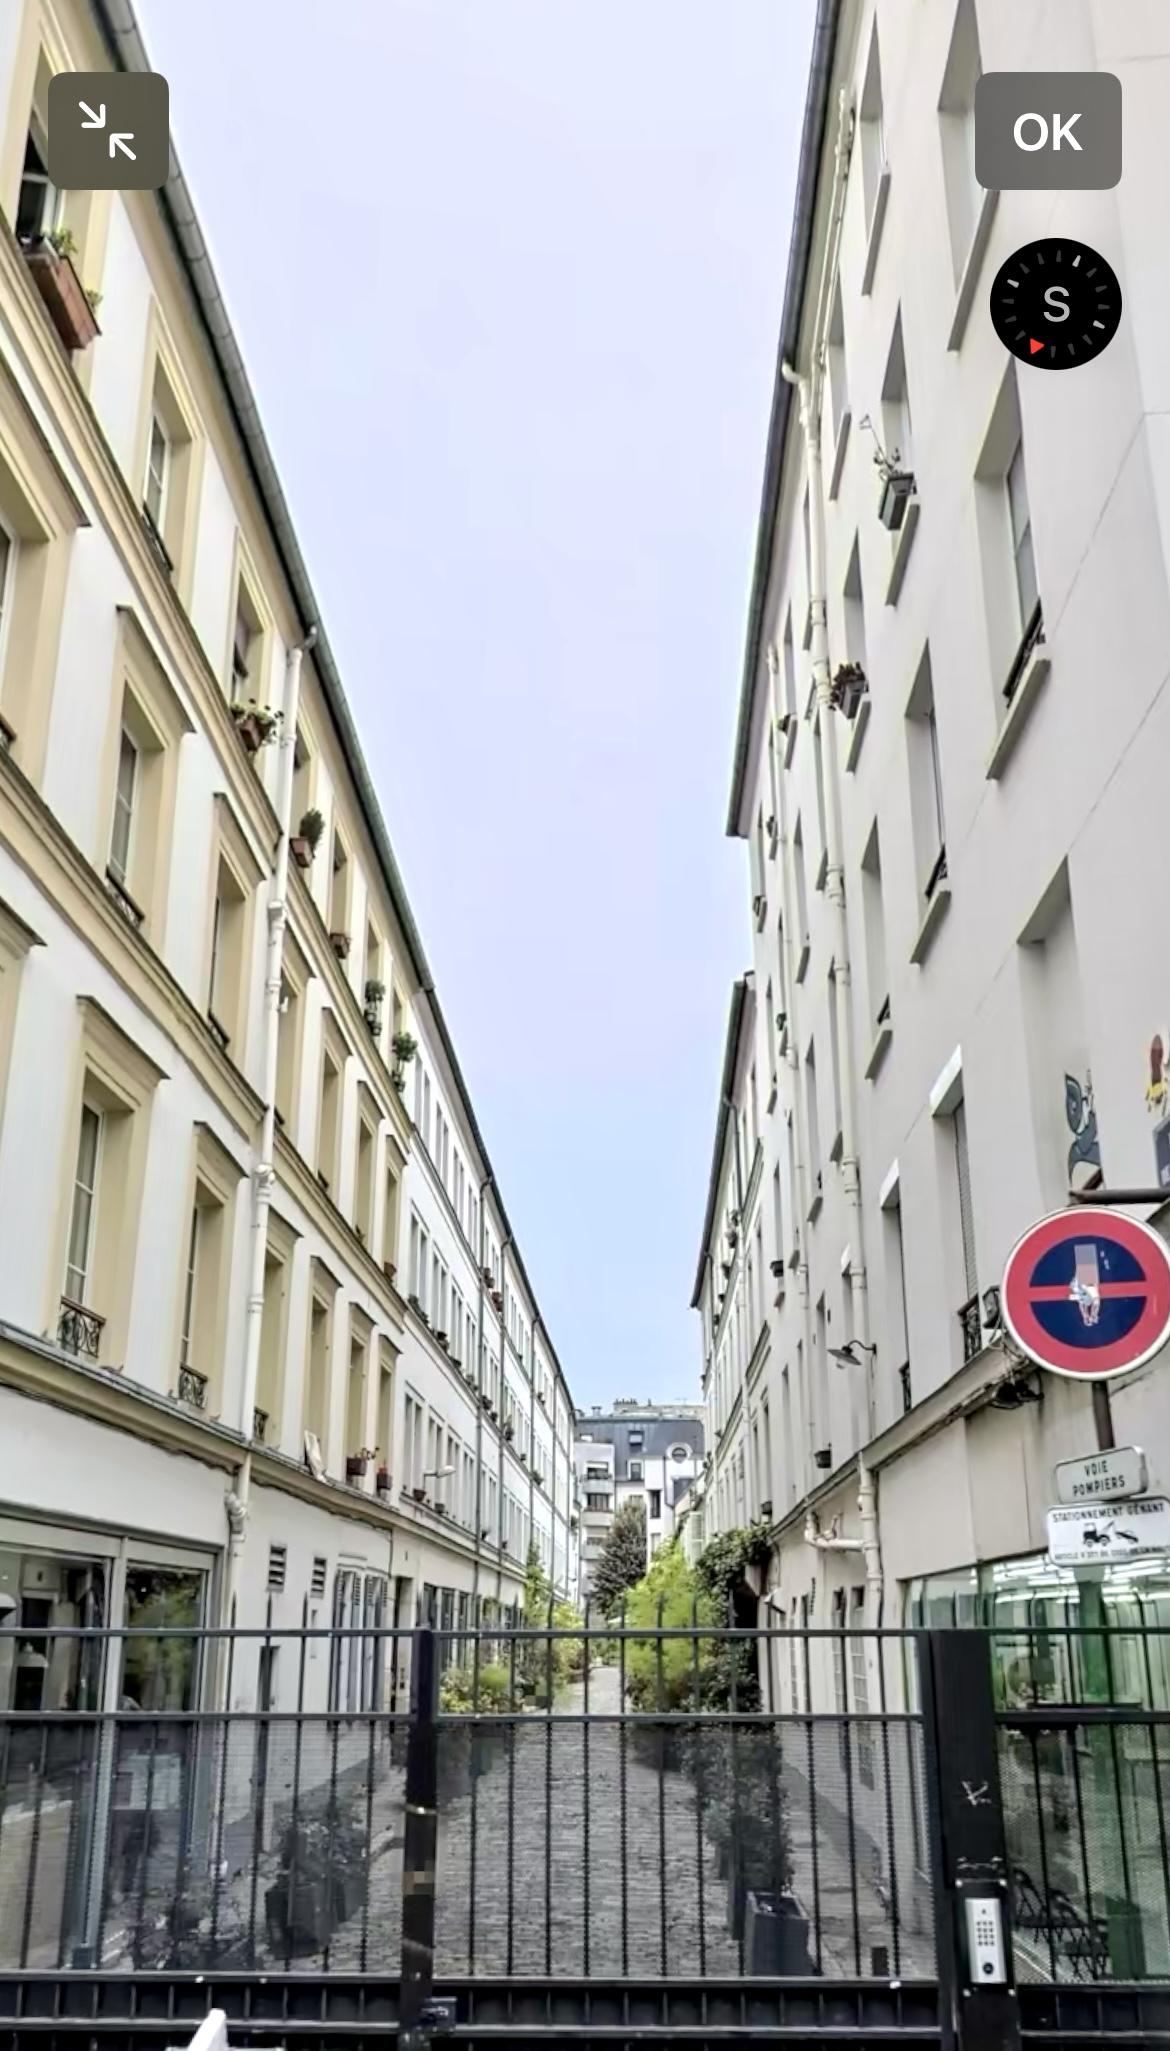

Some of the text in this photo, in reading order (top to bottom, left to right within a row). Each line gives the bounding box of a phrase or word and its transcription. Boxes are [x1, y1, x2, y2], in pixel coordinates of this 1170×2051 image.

[1084, 1460, 1108, 1476] VOIE
[1072, 1475, 1125, 1497] POMPIERS
[1052, 1507, 1122, 1523] STATIONNEMENT
